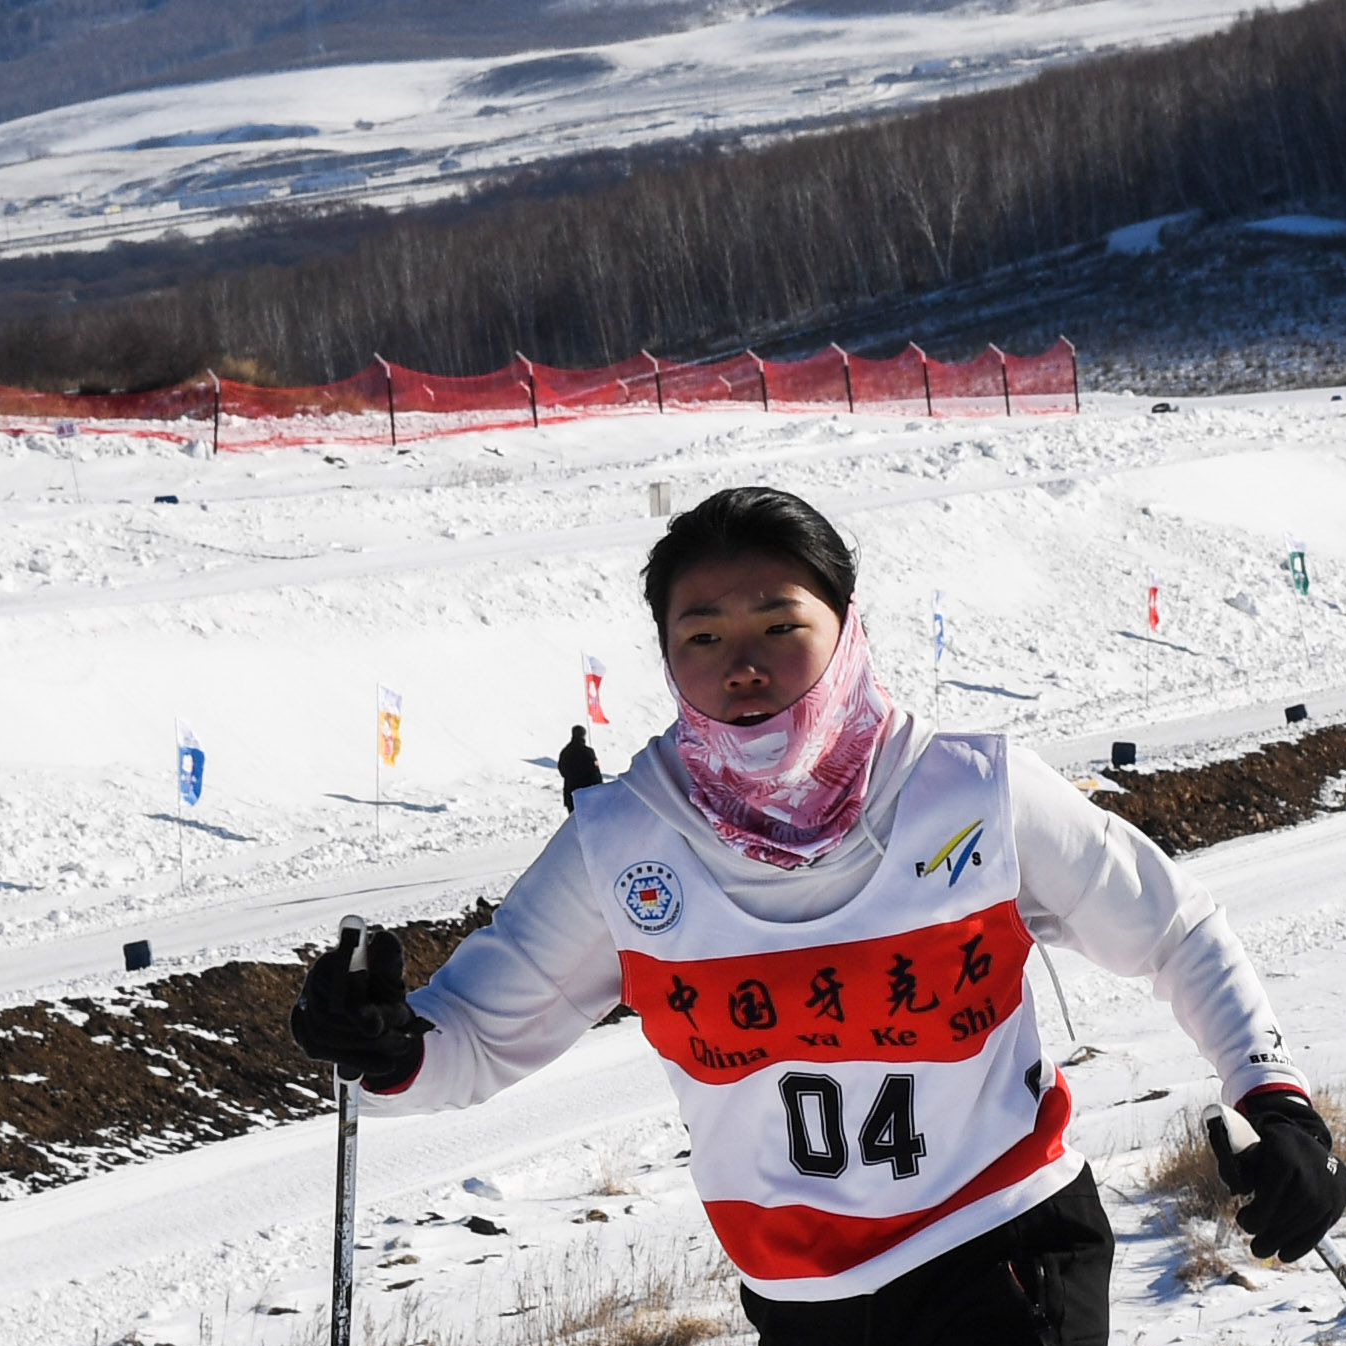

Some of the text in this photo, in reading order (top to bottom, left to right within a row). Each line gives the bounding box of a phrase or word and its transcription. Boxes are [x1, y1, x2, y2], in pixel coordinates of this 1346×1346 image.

[915, 851, 982, 878] FIS
[666, 933, 992, 1033] 中国牙克石
[689, 1036, 769, 1069] China
[870, 1027, 917, 1047] Ke
[949, 998, 996, 1042] Shi
[778, 1071, 927, 1181] 04
